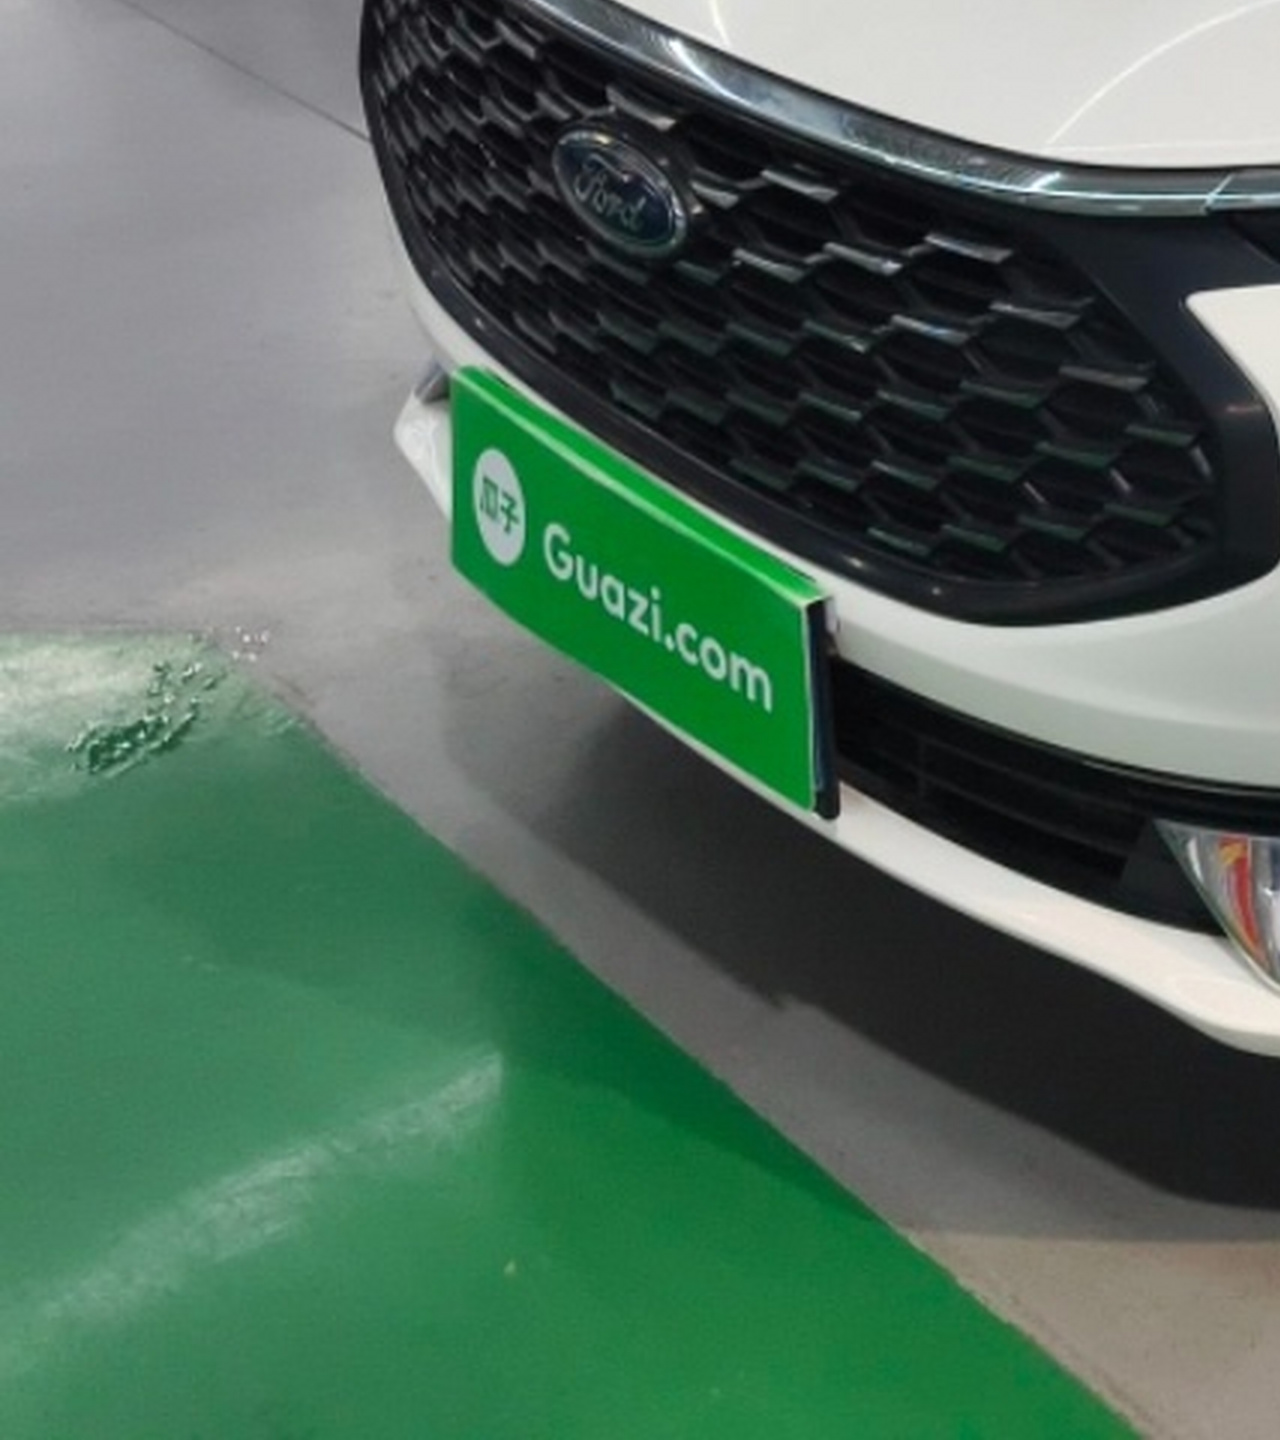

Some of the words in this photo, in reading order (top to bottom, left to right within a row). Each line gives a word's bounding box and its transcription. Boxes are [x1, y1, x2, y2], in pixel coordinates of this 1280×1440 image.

[572, 152, 648, 232] Ford
[480, 475, 520, 535] 瓜子
[543, 522, 773, 713] Guazi.com
